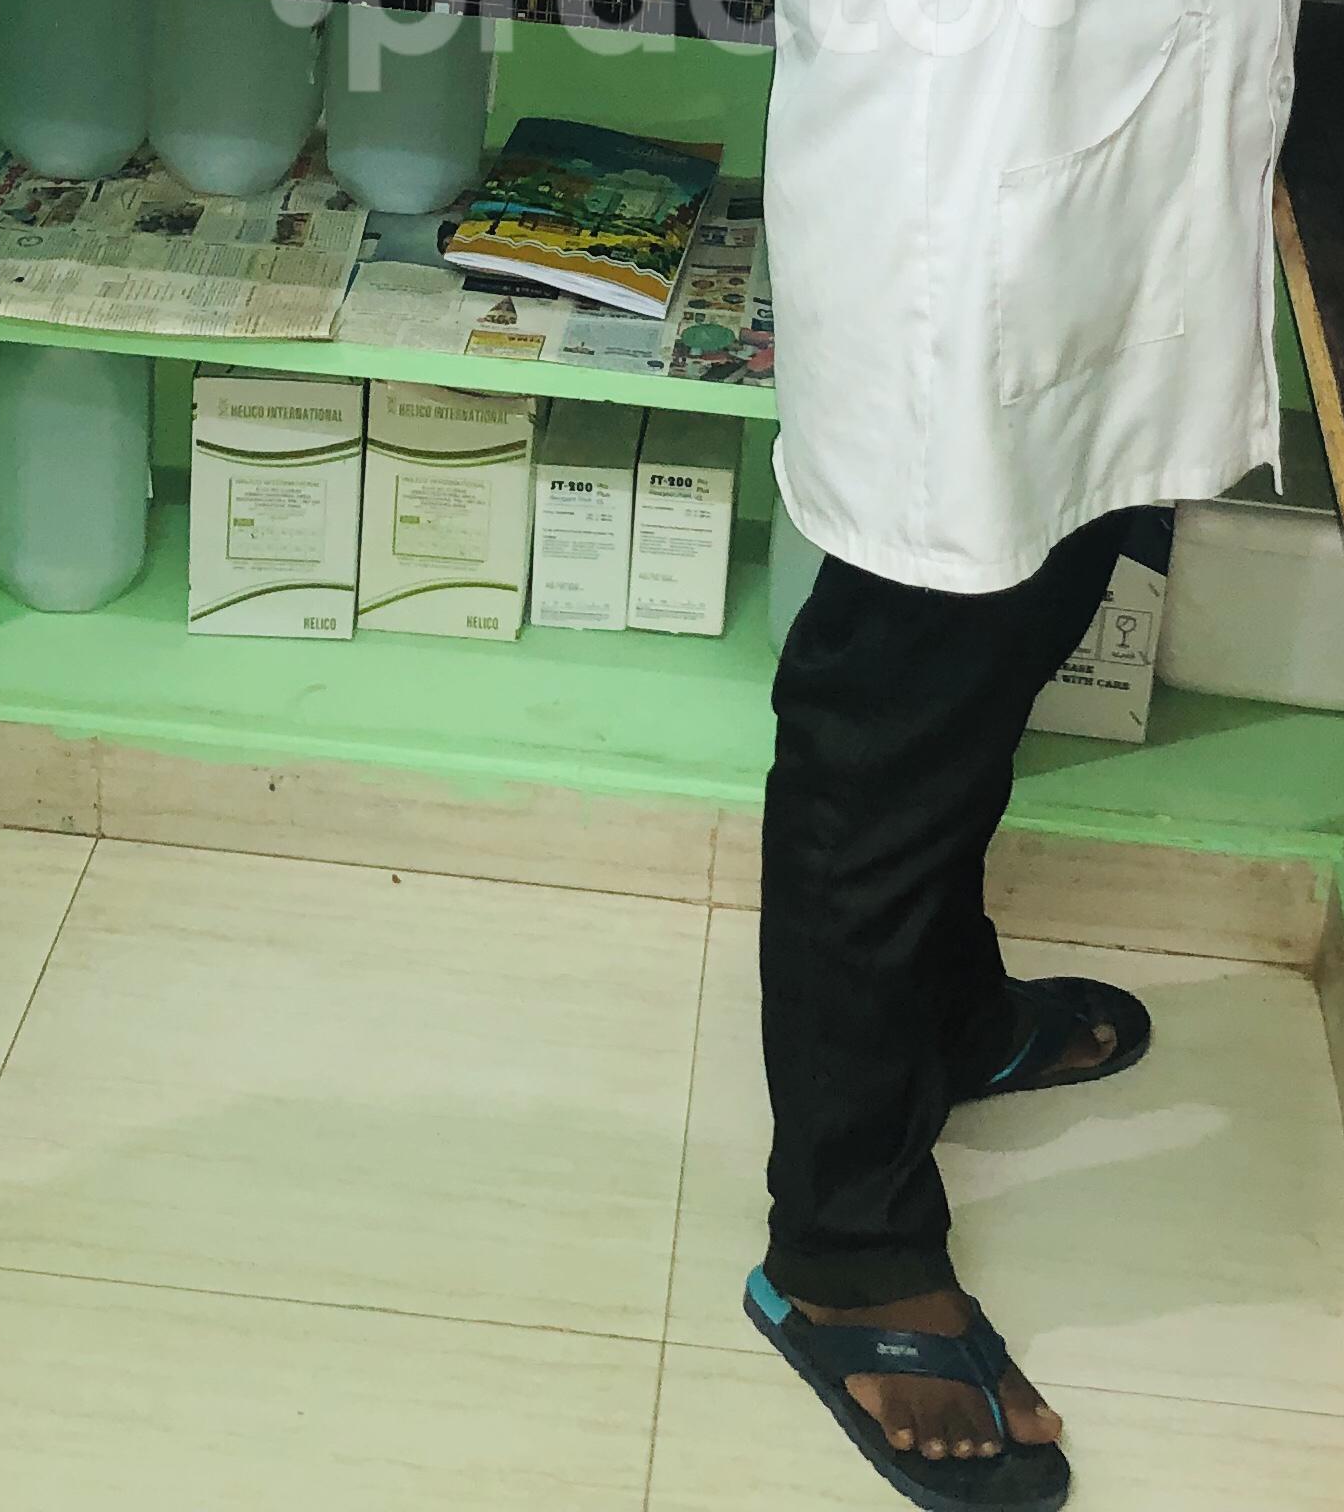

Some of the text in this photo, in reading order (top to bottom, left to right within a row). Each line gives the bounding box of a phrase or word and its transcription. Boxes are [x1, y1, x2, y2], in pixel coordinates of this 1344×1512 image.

[230, 404, 344, 423] HELICO INTERNATIONAL
[398, 403, 432, 418] HELICO
[550, 480, 593, 493] ST-200
[649, 474, 693, 488] ST-200
[303, 616, 337, 631] HELICO
[466, 615, 500, 630] HELICO
[1061, 674, 1131, 691] WITH CARE
